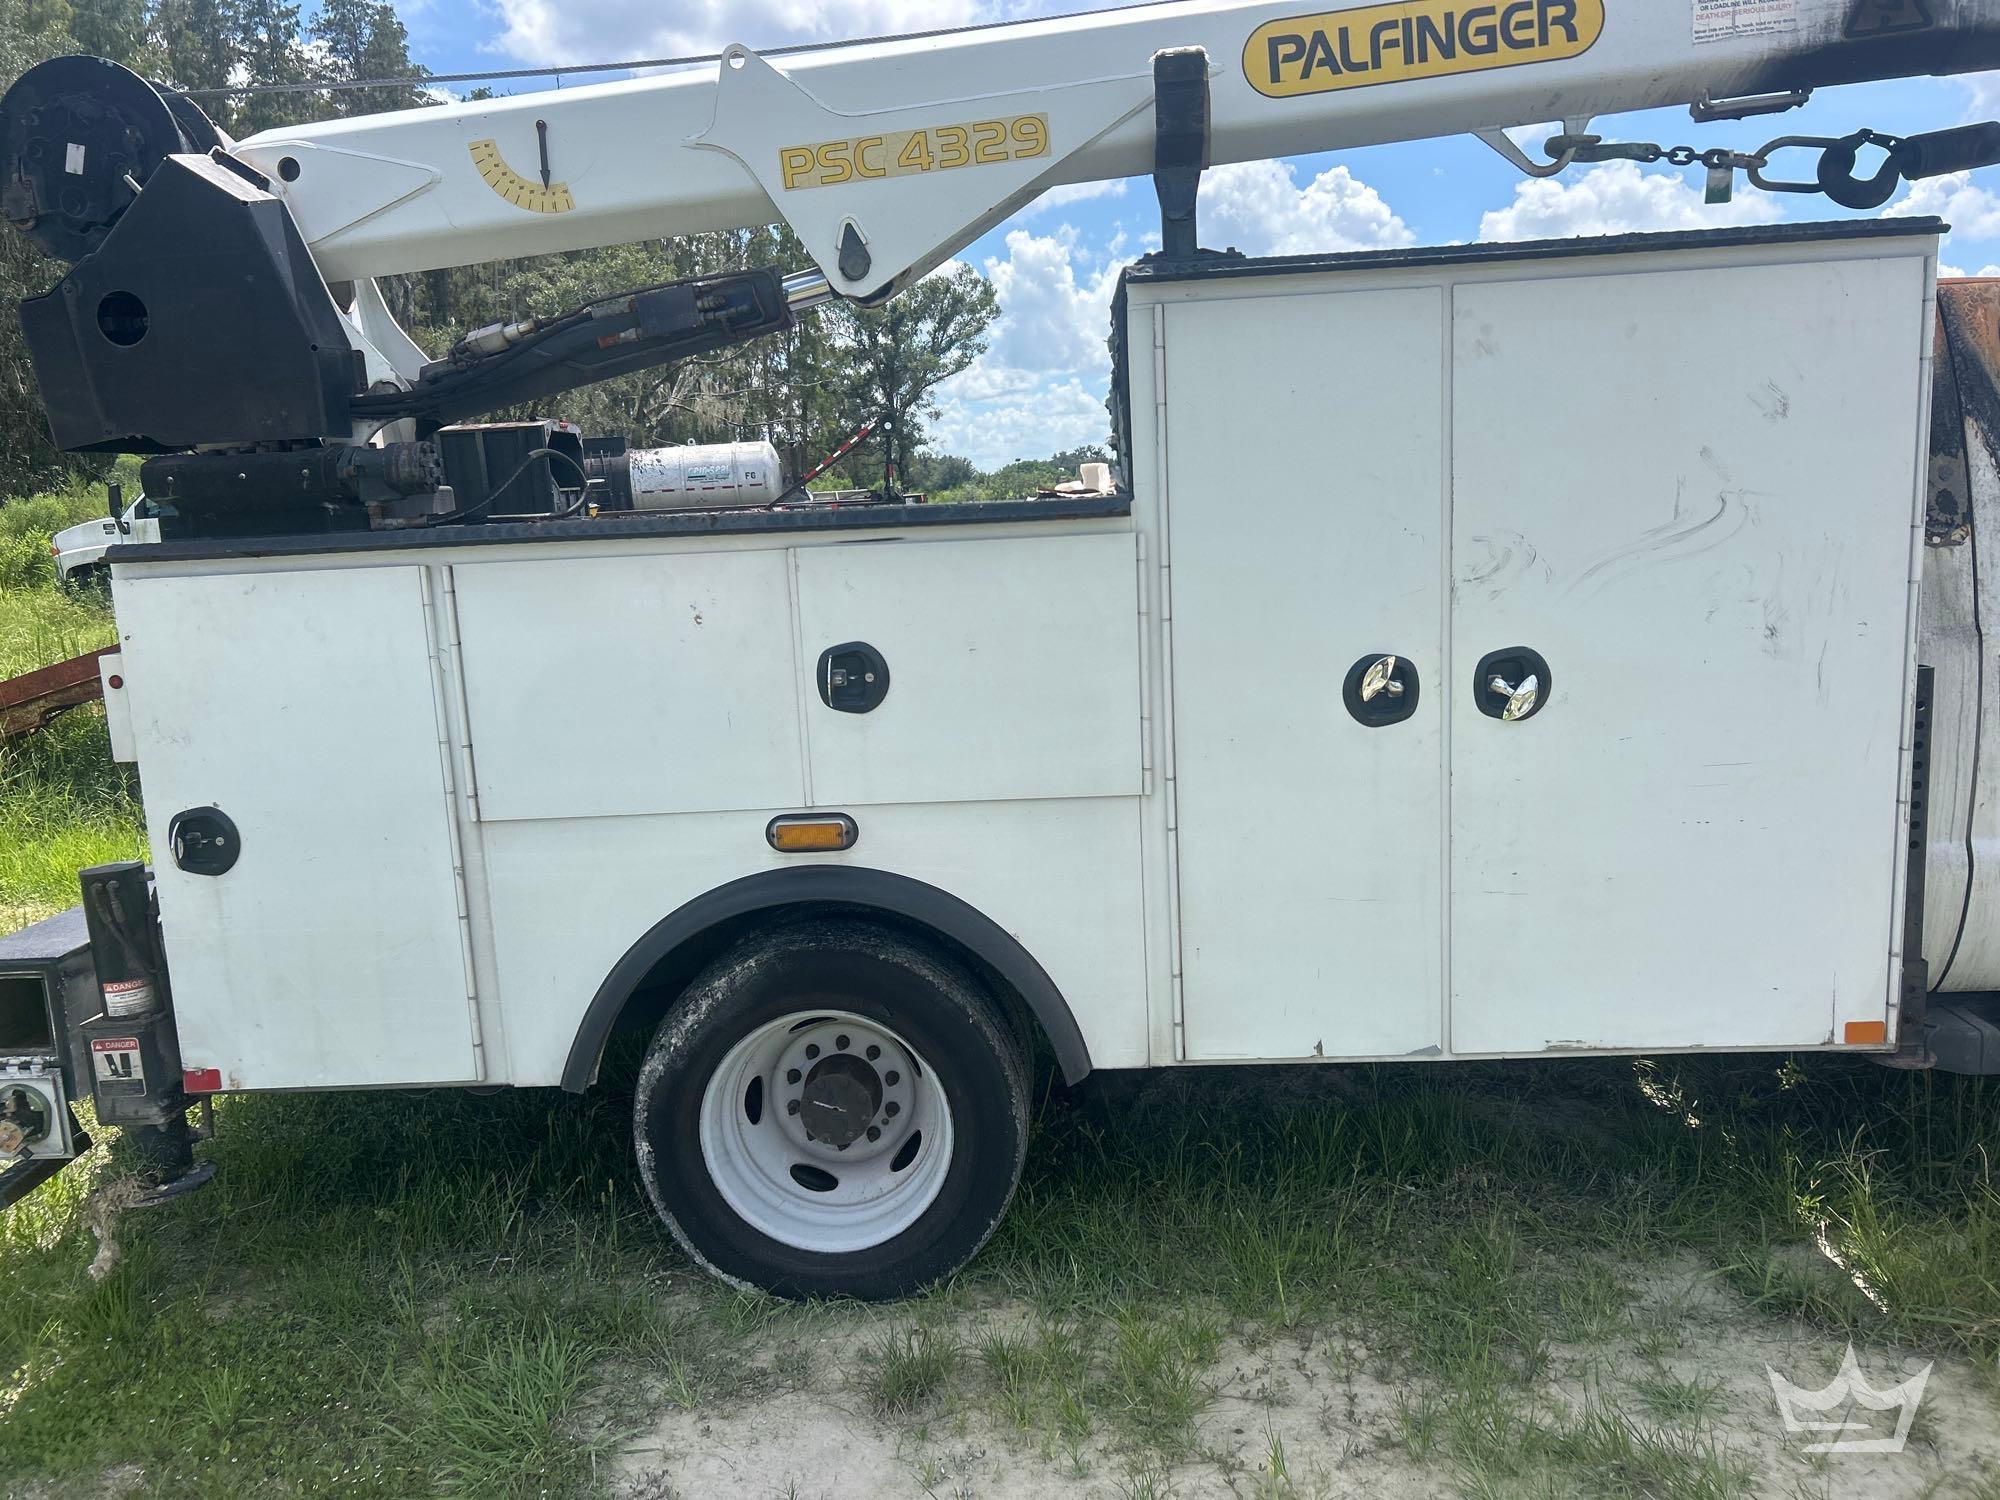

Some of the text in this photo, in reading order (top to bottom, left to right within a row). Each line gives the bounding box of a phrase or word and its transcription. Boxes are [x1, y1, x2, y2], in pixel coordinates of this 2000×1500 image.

[1695, 3, 1792, 21] DEATH OR SERIOUS INJURY
[1267, 0, 1578, 84] PALFINGER
[781, 116, 1047, 189] PSC 4329
[112, 979, 145, 991] DANGE
[105, 1041, 136, 1049] DANGER
